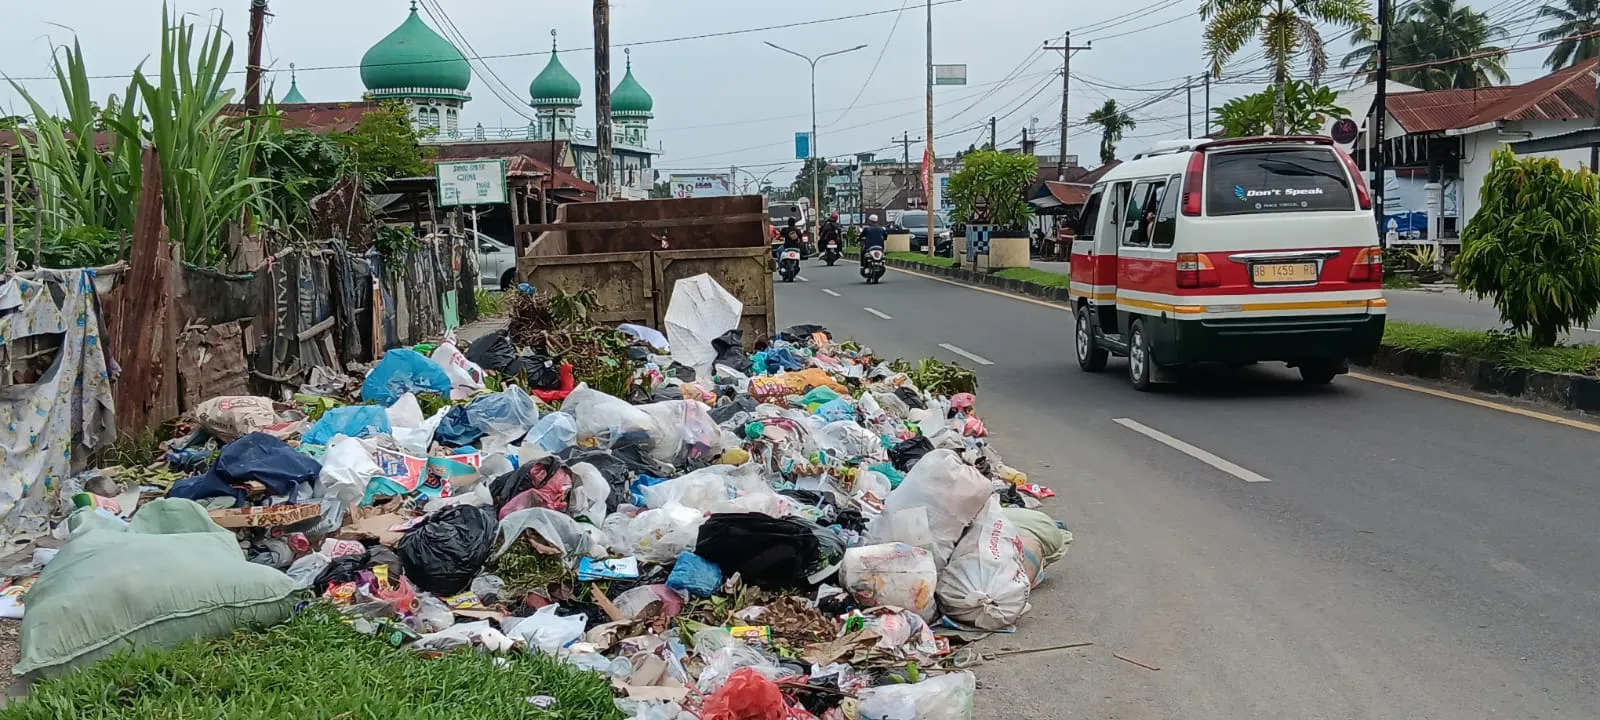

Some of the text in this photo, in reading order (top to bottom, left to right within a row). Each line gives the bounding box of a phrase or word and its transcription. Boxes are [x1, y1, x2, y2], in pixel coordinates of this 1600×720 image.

[1246, 187, 1323, 197] Don't Speak
[1254, 265, 1266, 277] BB
[1272, 265, 1294, 276] 1459
